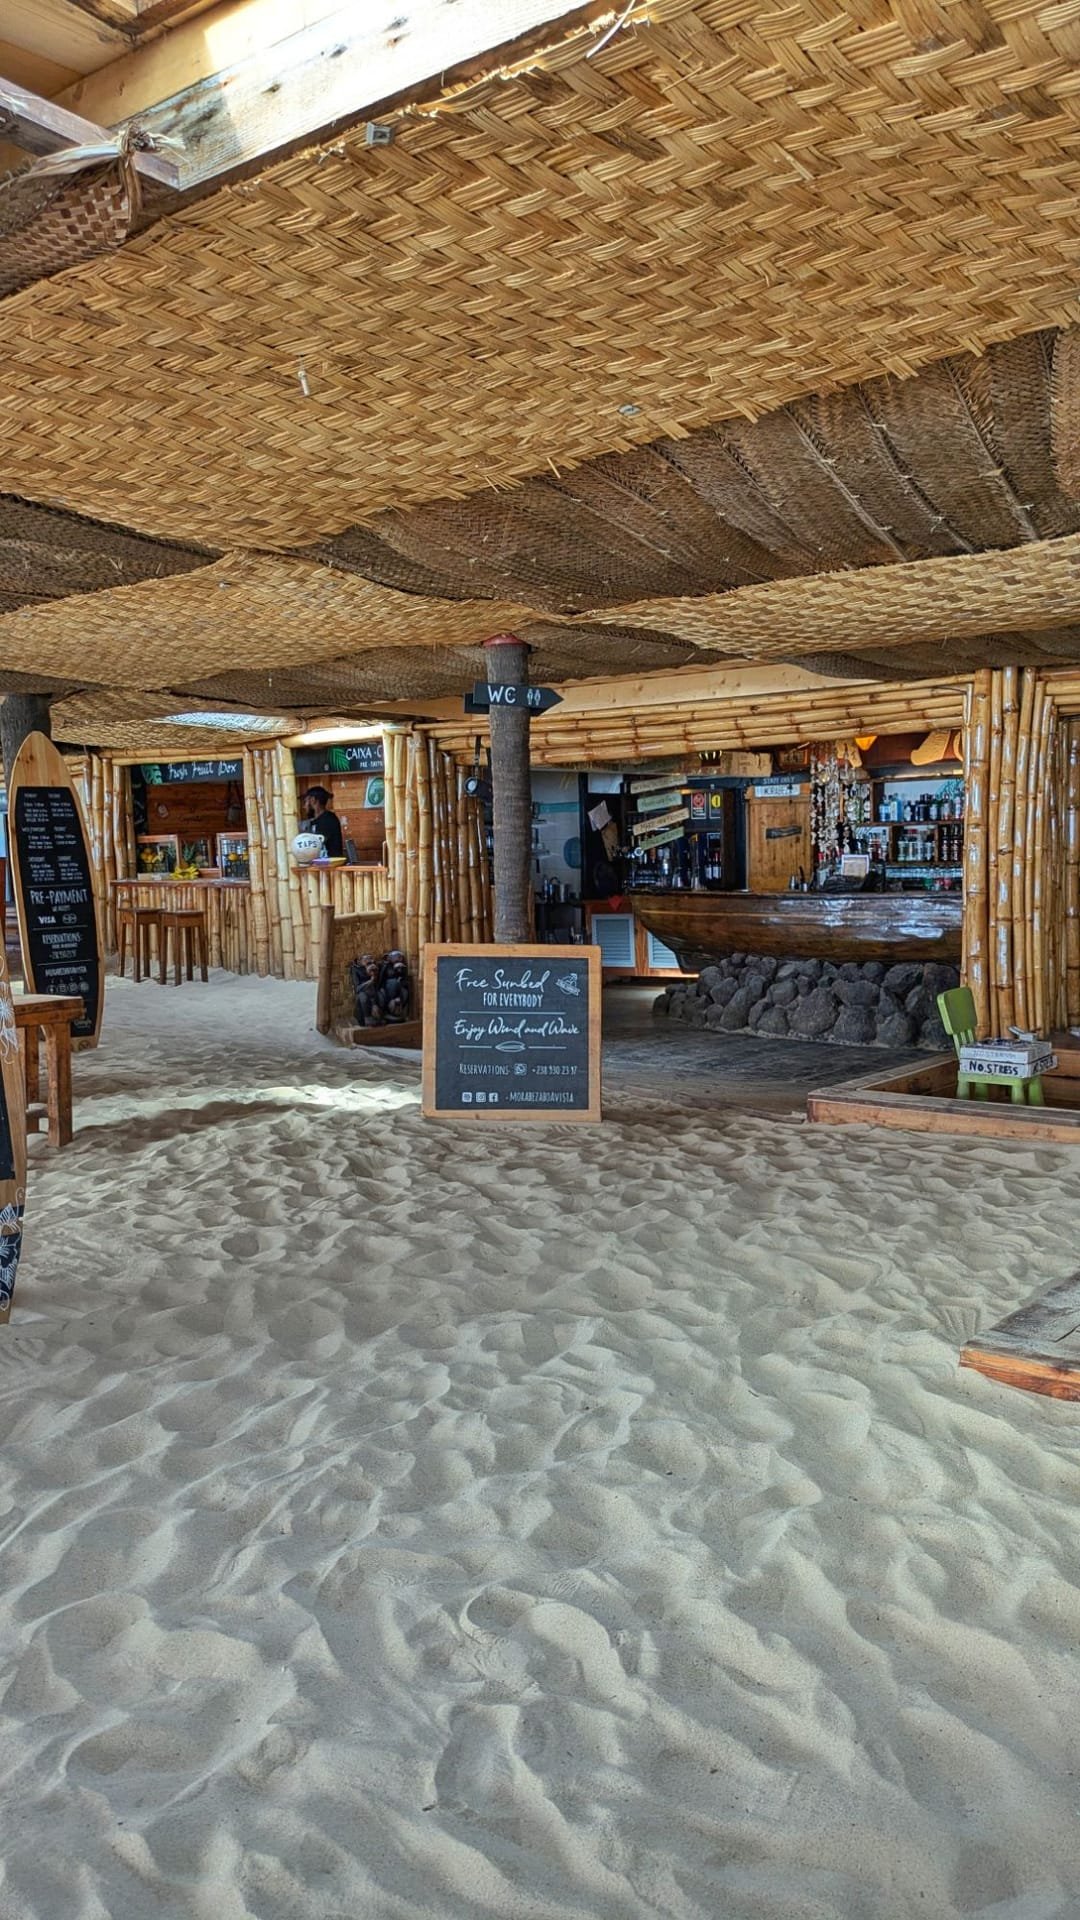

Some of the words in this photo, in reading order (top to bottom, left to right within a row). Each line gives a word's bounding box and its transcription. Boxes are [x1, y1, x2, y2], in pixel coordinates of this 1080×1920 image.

[487, 684, 516, 704] WC
[345, 746, 373, 761] CAIXA
[297, 840, 318, 850] TIPS
[30, 889, 88, 905] PRE-PAYMENT
[38, 915, 57, 924] VISA
[455, 968, 489, 992] Free
[492, 969, 551, 993] Sunbed
[483, 992, 498, 1007] FOR
[499, 993, 544, 1008] EVERYBODY
[454, 1018, 487, 1041] Enjoy
[488, 1016, 527, 1039] Wind
[525, 1021, 550, 1037] and
[548, 1018, 580, 1035] Wave
